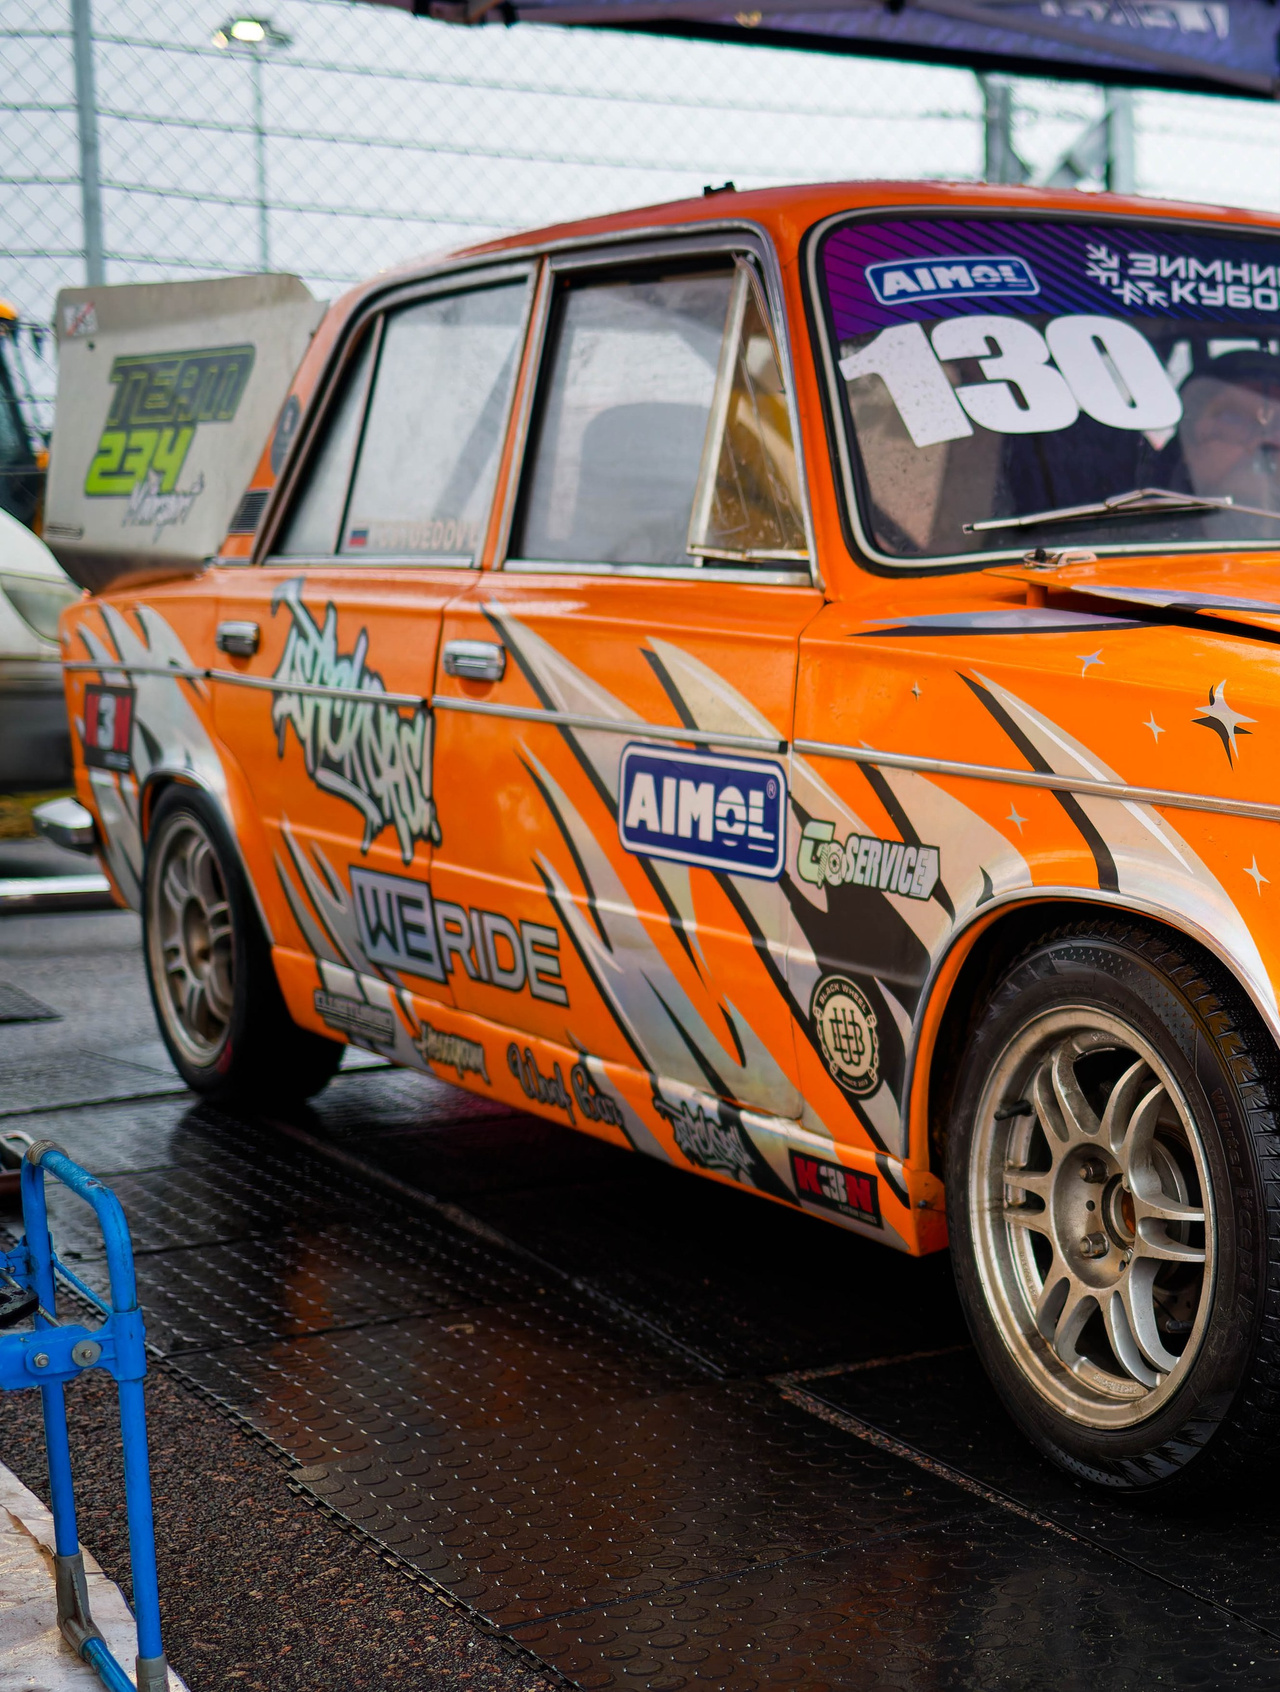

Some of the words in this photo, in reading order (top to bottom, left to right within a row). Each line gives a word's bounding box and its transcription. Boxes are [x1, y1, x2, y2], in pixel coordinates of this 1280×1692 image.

[883, 264, 1030, 297] AIMOL
[108, 345, 256, 427] TEAM
[839, 314, 1182, 448] 130
[85, 426, 196, 497] 234
